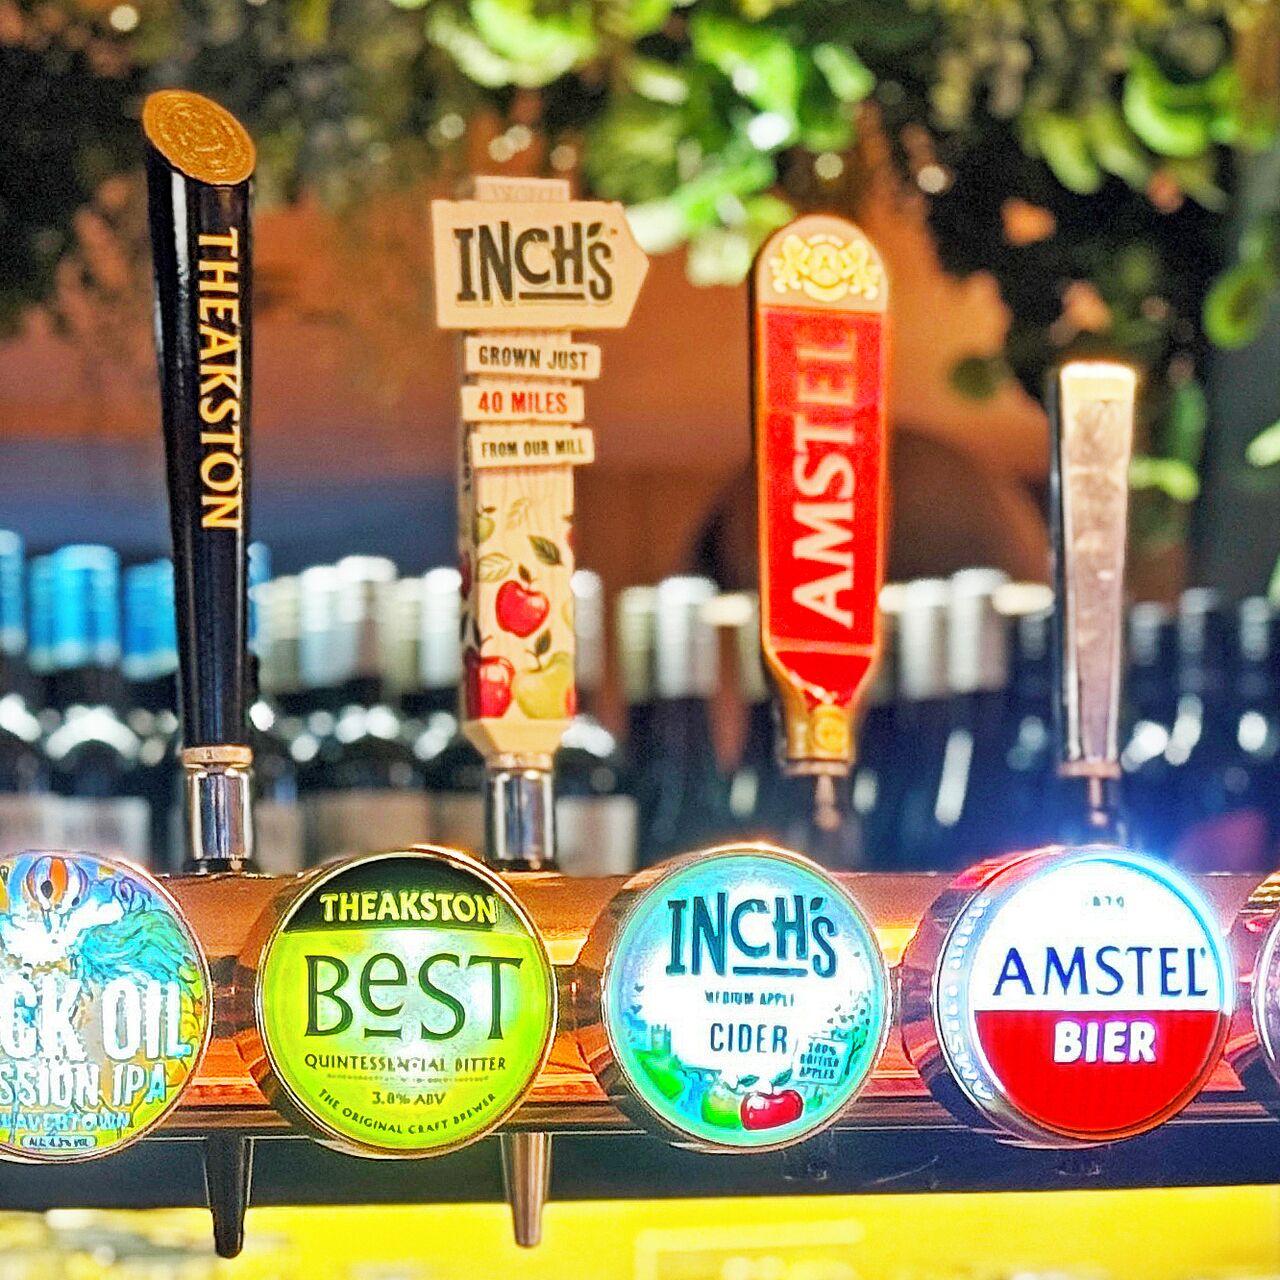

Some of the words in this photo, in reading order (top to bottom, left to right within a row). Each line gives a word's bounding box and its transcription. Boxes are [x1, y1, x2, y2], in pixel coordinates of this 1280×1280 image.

[452, 221, 613, 301] INCH'S
[198, 226, 243, 529] THEAKSTON
[478, 345, 541, 369] GROWN
[547, 350, 588, 370] JUST
[478, 391, 504, 413] 40
[511, 391, 568, 414] MILES
[481, 440, 518, 458] FROM
[524, 440, 549, 456] OUR
[555, 438, 586, 455] MILL
[792, 328, 856, 629] AMSTEL
[320, 890, 498, 924] THEAKSTON
[665, 891, 838, 978] INCH'S
[993, 945, 1209, 997] AMSTEL
[101, 979, 192, 1060] OIL
[709, 1022, 788, 1055] CIDER
[305, 1053, 446, 1073] QUINTESSENIAL
[455, 1056, 507, 1073] BITTER
[1053, 1020, 1157, 1064] BIER
[111, 1063, 168, 1104] IPA
[318, 1088, 340, 1110] THE
[342, 1107, 403, 1135] ORIGINAL
[407, 1119, 449, 1135] CRAFT
[453, 1092, 497, 1126] BREWER
